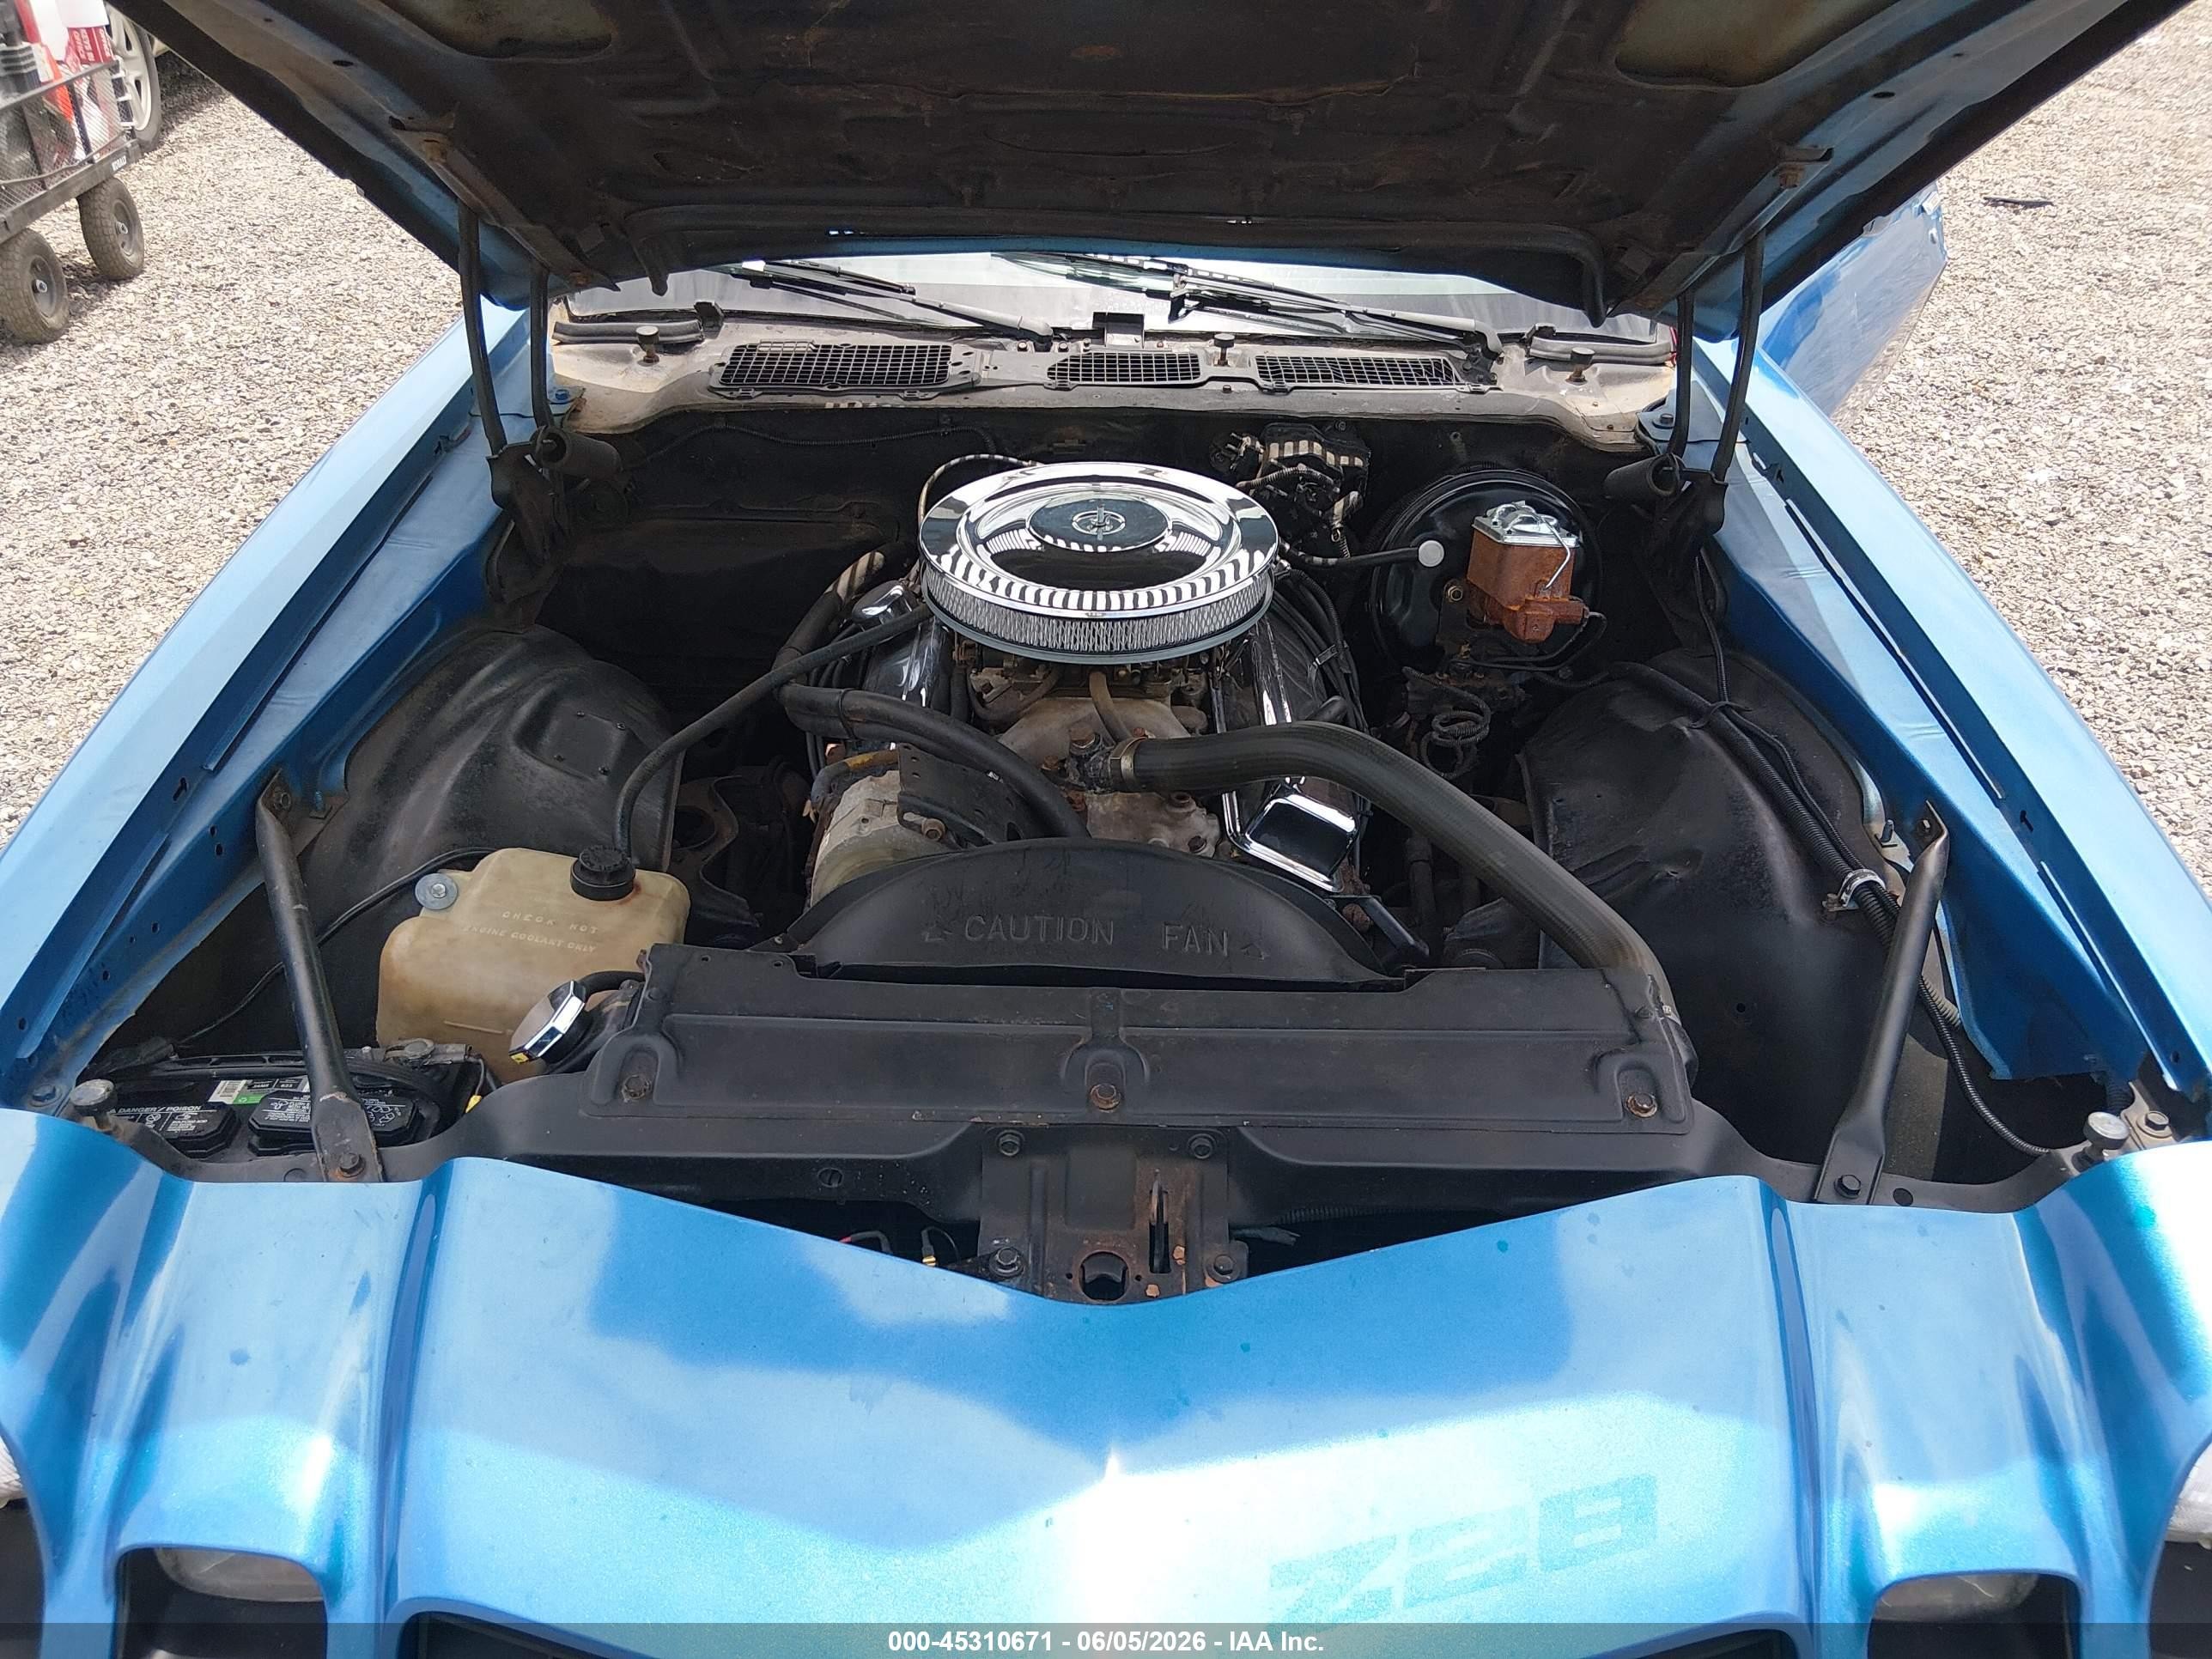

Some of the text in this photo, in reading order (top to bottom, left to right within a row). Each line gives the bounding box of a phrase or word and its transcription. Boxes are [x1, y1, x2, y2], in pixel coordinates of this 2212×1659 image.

[501, 910, 556, 926] CHECK
[463, 925, 597, 953] ENGINE COOLANT ONLY
[964, 915, 1229, 957] CAUTION FAN
